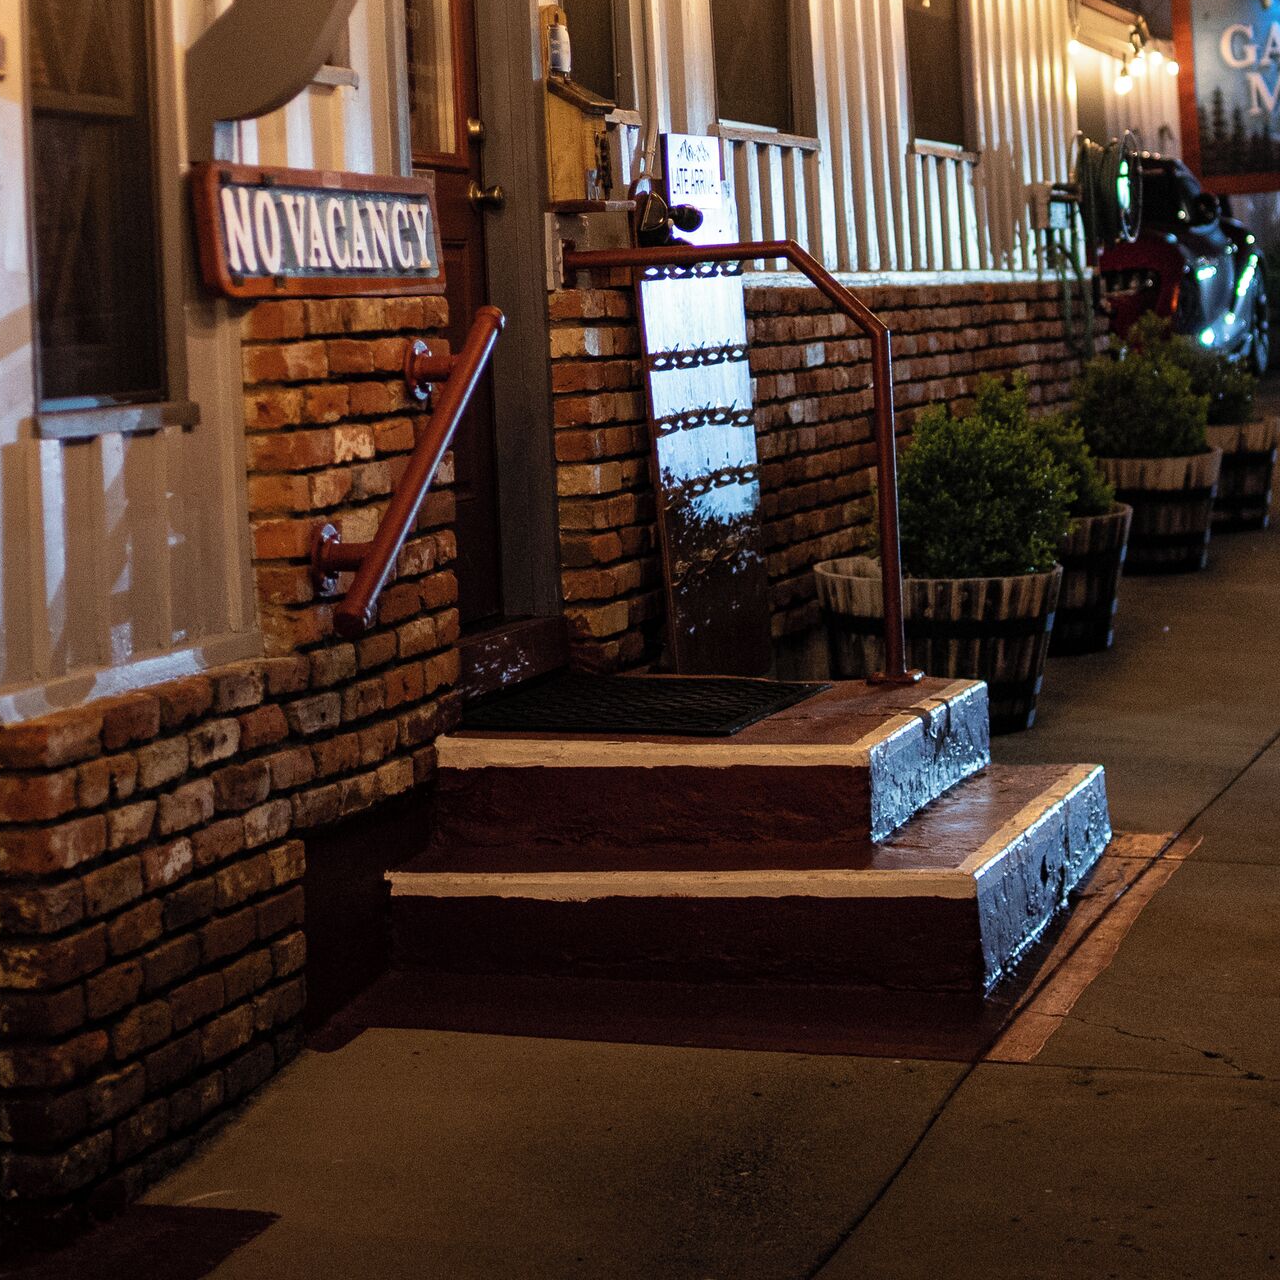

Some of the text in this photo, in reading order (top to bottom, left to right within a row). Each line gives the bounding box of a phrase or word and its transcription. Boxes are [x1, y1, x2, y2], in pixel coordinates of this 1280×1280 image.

[671, 167, 689, 194] LATE
[222, 187, 431, 273] NO VACANCY
